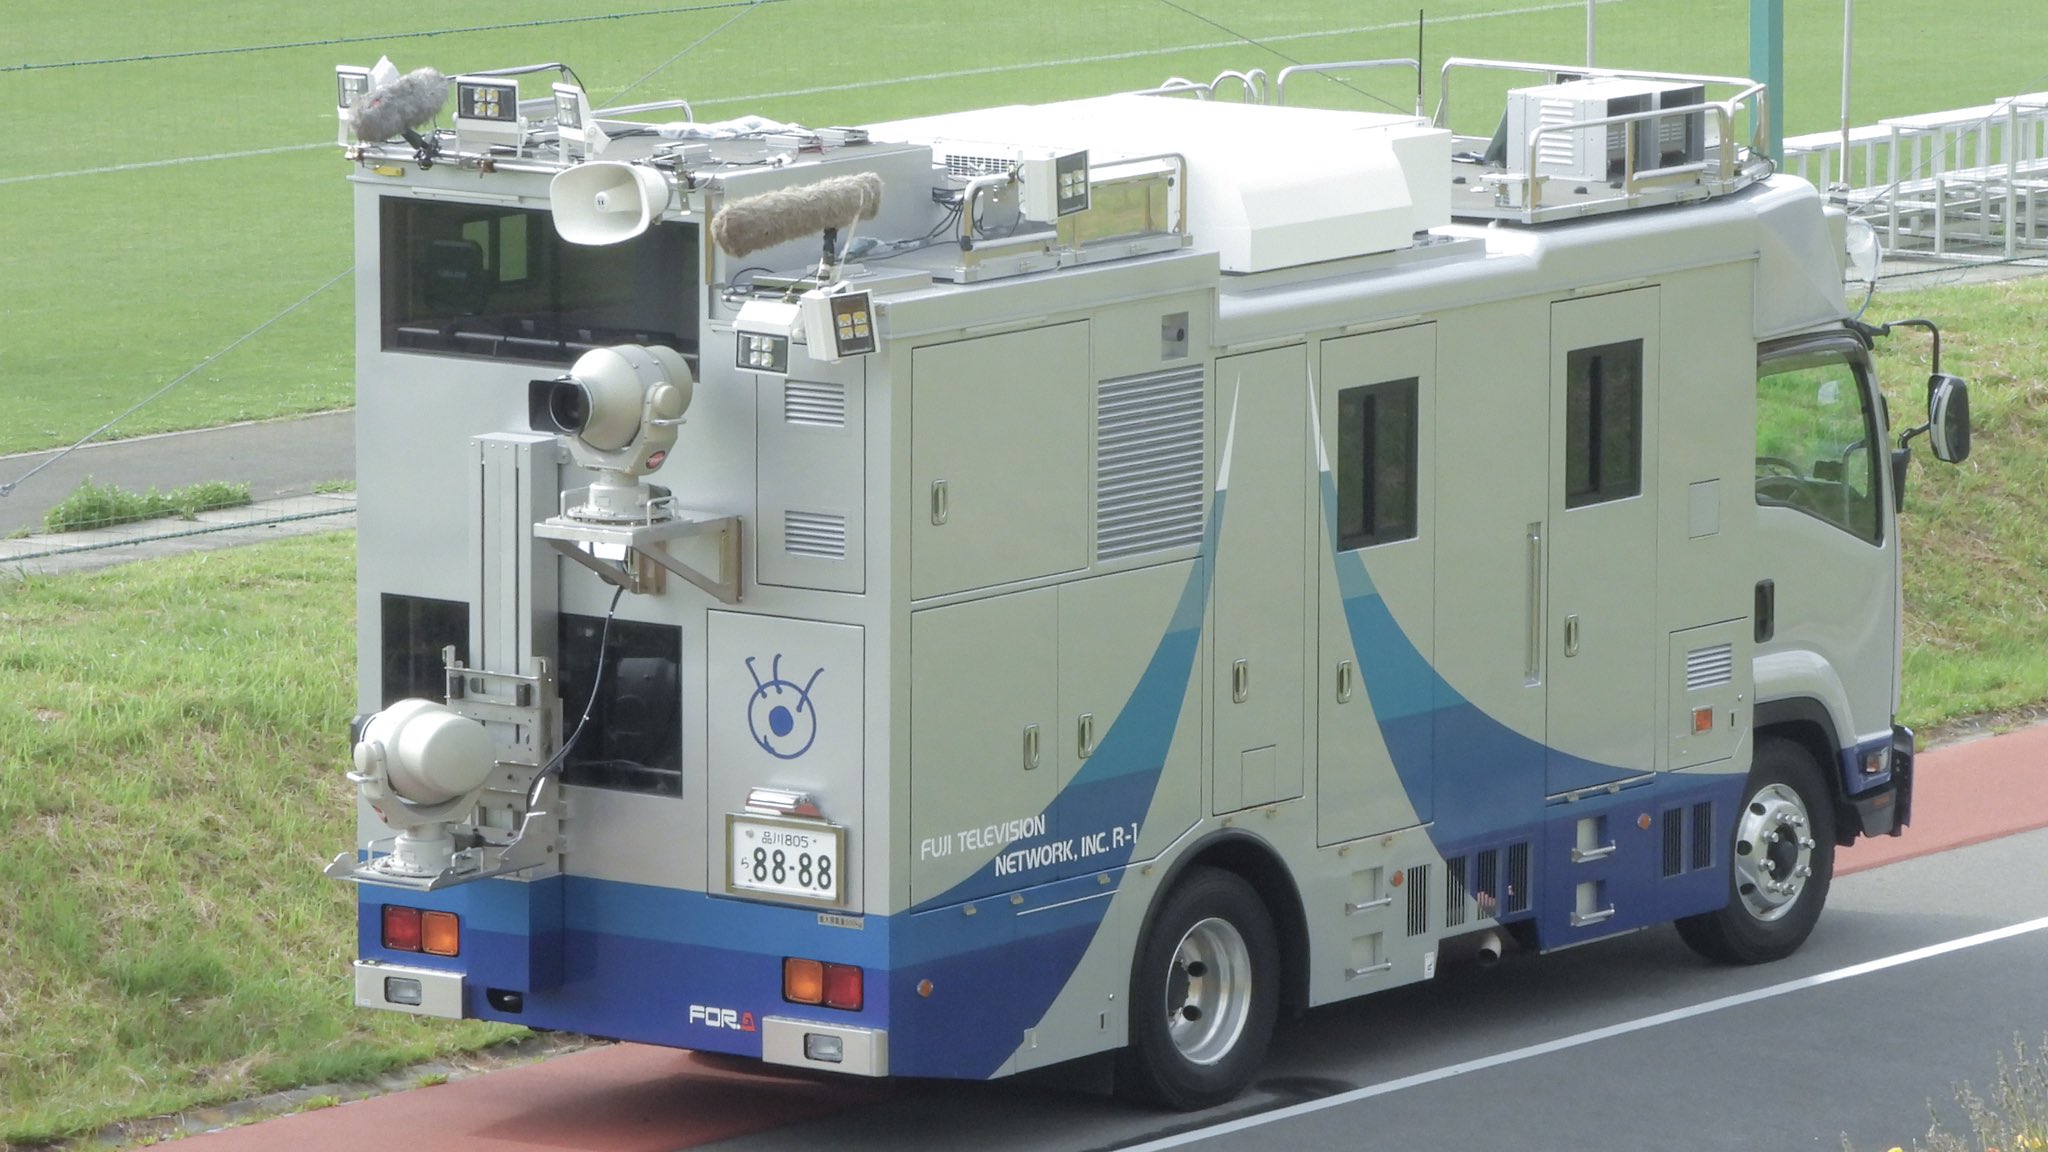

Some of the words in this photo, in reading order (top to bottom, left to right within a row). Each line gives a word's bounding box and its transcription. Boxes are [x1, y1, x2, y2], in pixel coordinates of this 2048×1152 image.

[921, 835, 952, 861] FUJI
[957, 814, 1046, 851] TELEVISION
[995, 839, 1078, 877] NETWORK,
[1081, 832, 1109, 858] INC.
[1112, 822, 1138, 849] R-1
[753, 846, 832, 890] 88-88
